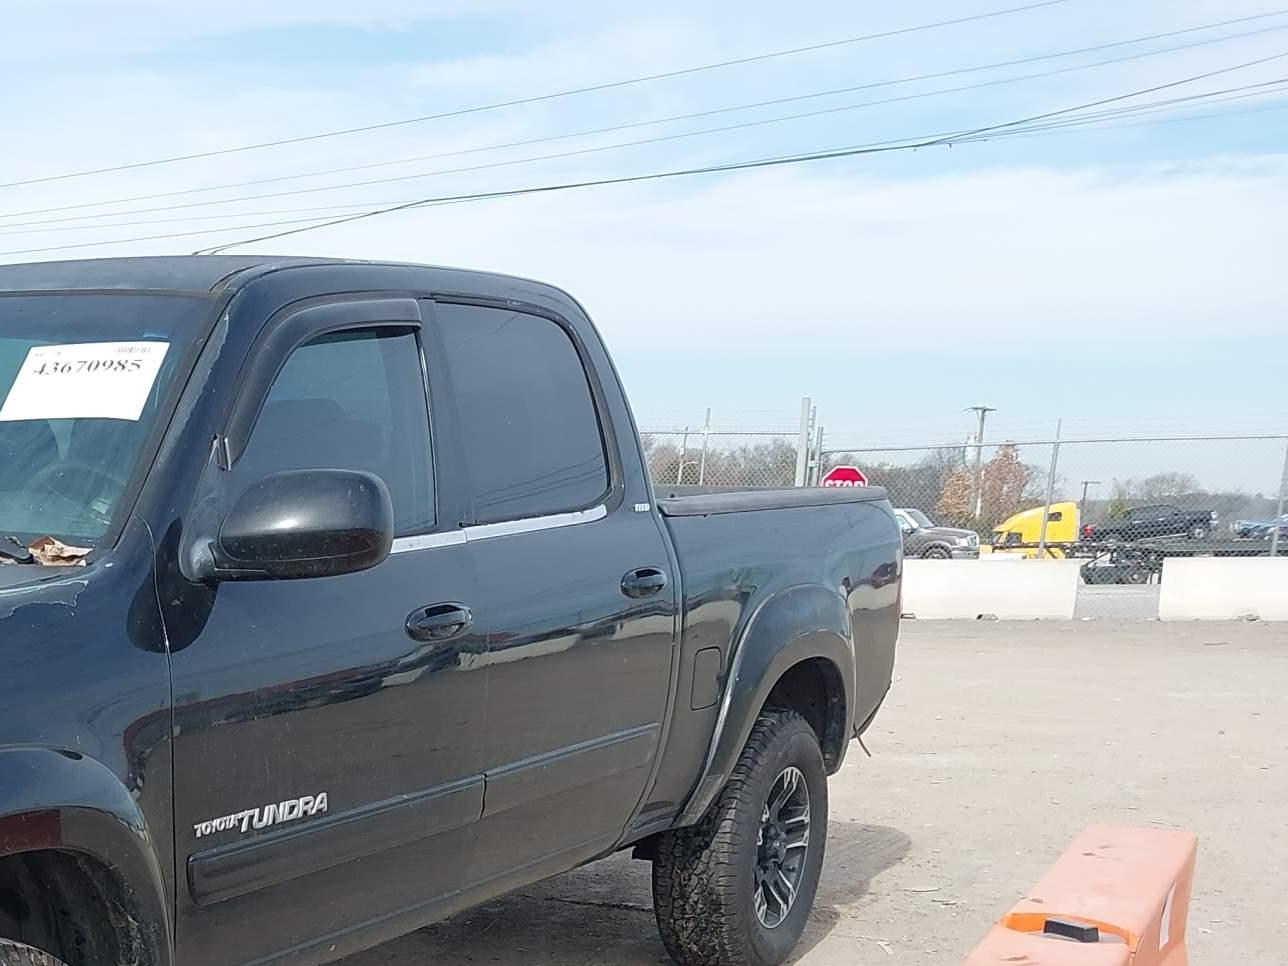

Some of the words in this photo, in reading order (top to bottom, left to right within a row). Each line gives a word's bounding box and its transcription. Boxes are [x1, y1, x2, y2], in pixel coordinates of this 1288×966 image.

[33, 359, 143, 376] 43670985
[193, 813, 239, 838] TOYOTA
[238, 792, 328, 833] TUNDRA
